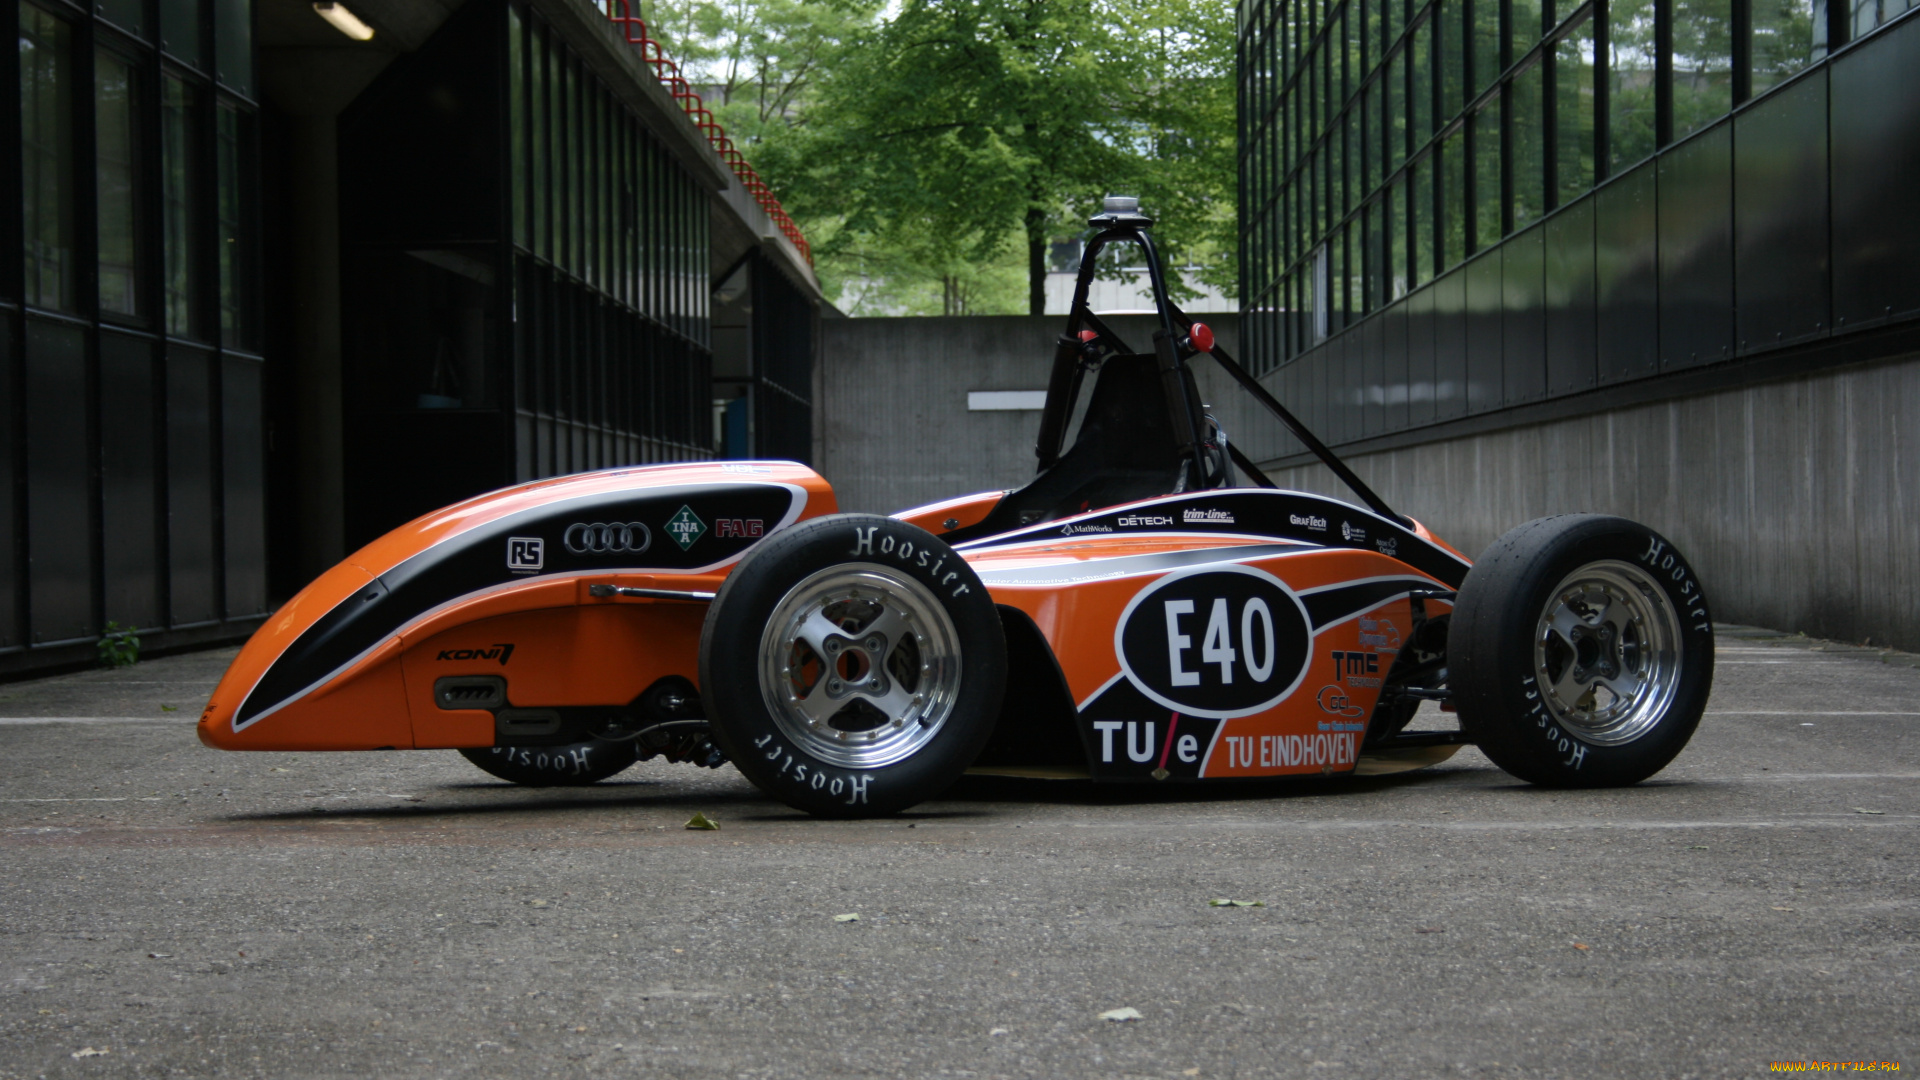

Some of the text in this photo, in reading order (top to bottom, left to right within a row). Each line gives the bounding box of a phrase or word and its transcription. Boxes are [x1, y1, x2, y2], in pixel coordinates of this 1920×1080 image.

[510, 540, 541, 566] RS
[716, 519, 763, 537] FAG
[1074, 525, 1113, 533] MathWorks
[850, 527, 970, 598] Hoosier
[1640, 536, 1709, 633] Hoosier
[1164, 597, 1275, 687] E40
[1522, 675, 1591, 771] Hoosier
[492, 746, 594, 775] Hoosi
[755, 733, 875, 805] Hoosier
[1225, 733, 1355, 768] TU EINDHOVEN
